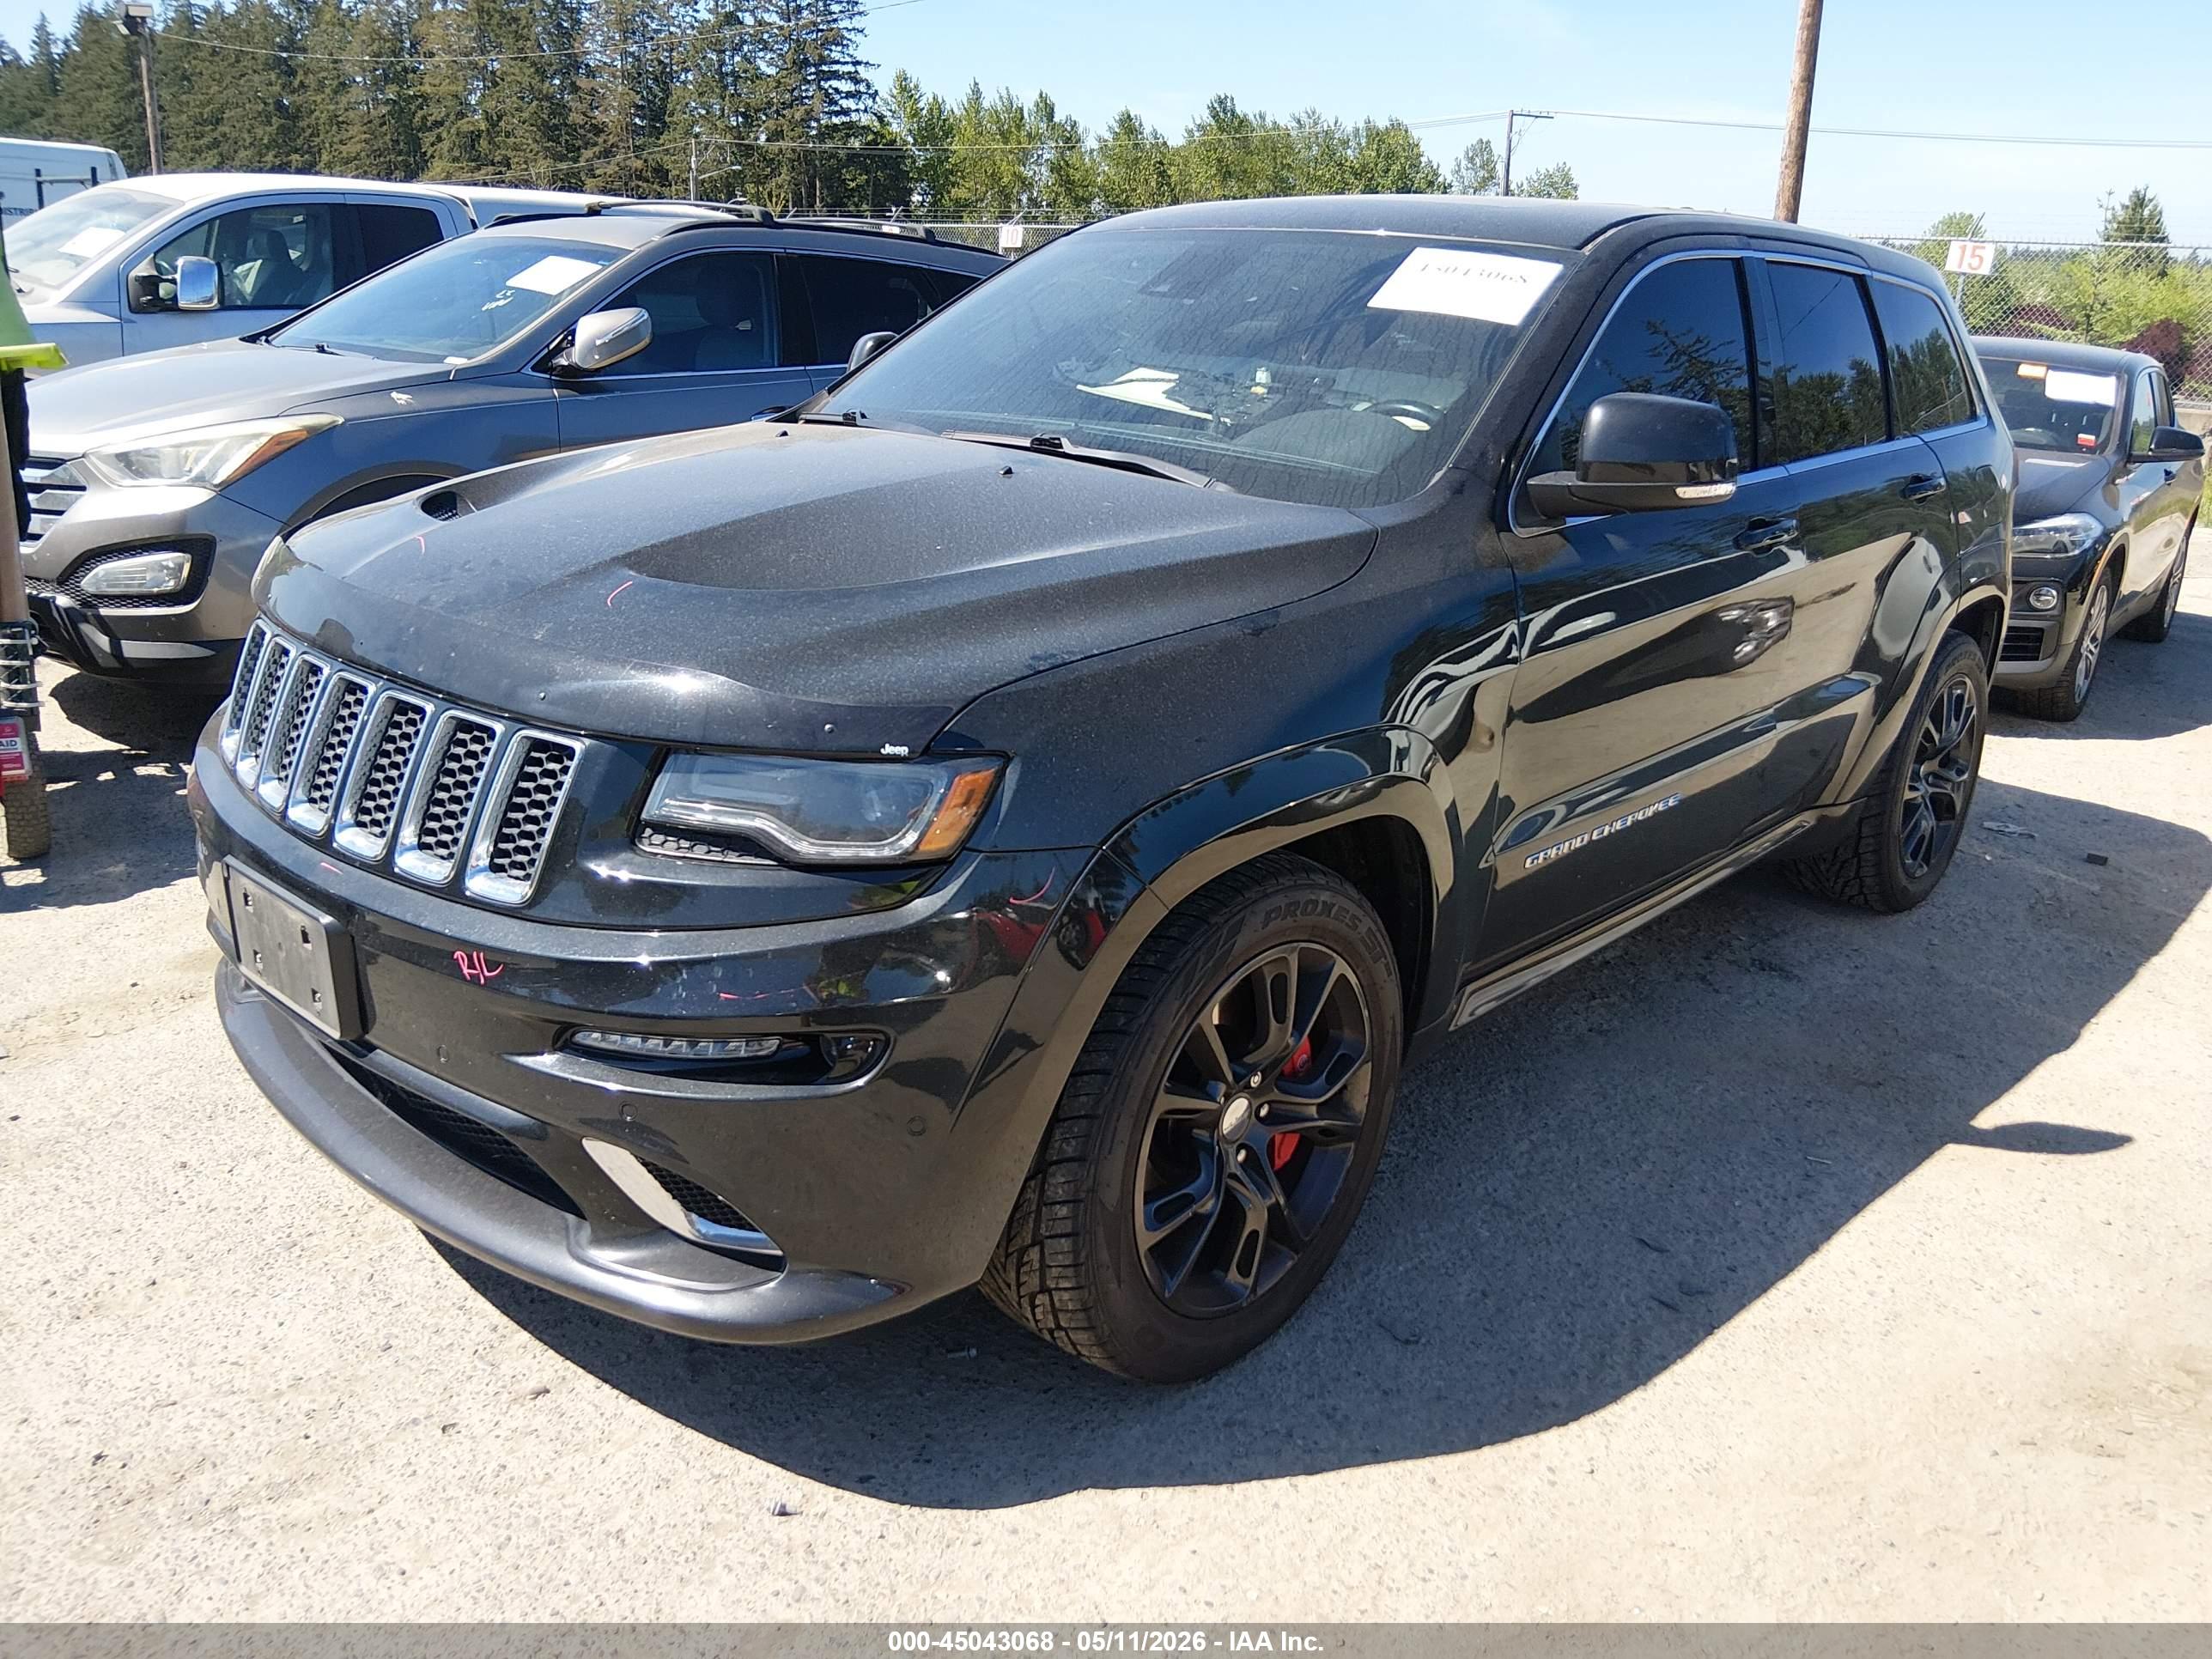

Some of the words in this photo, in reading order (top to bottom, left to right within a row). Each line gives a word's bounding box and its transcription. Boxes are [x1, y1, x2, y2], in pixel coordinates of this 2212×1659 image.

[1957, 244, 1986, 270] 15
[880, 744, 909, 757] Jeep
[1524, 831, 1590, 869] GRAND
[1590, 792, 1684, 842] CHEROKEE
[1261, 898, 1363, 933] PROXES
